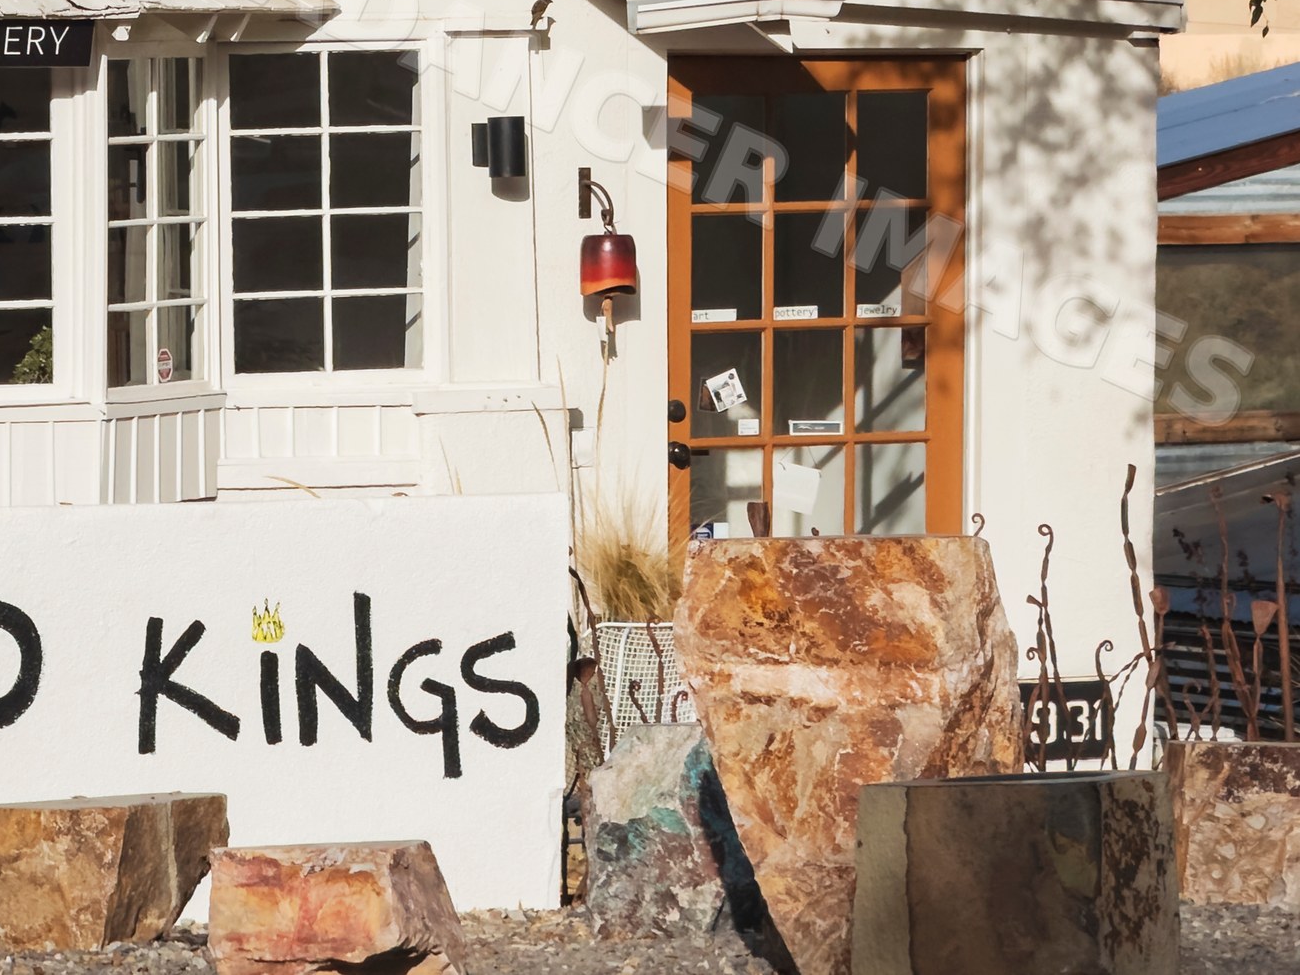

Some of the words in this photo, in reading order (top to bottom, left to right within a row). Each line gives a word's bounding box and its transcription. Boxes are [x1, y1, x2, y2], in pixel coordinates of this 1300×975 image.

[774, 308, 814, 318] pottery
[858, 305, 898, 316] jewelry
[693, 312, 709, 321] art
[1020, 700, 1103, 744] 931
